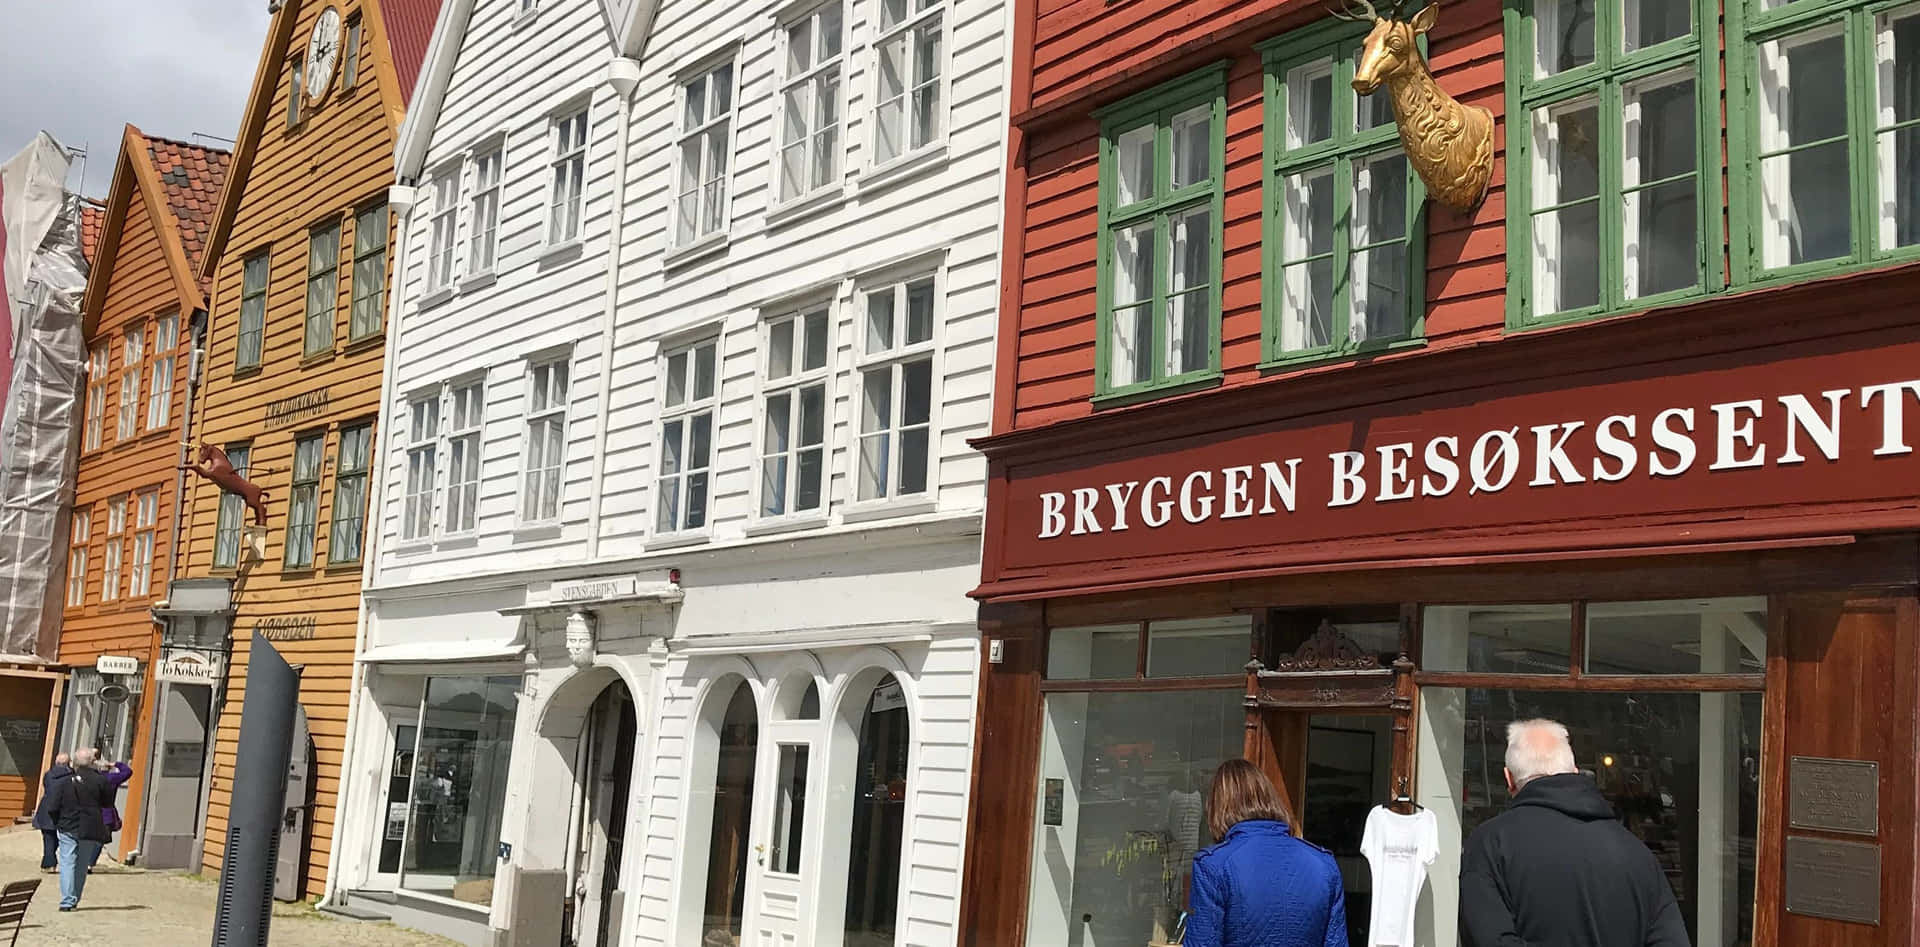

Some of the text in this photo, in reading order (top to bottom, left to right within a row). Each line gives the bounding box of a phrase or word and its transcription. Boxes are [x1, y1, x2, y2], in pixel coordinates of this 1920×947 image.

[1038, 380, 1920, 538] BRYGGEN BESØKSSENT
[103, 661, 132, 669] BARBER
[161, 663, 213, 678] To Kokker
